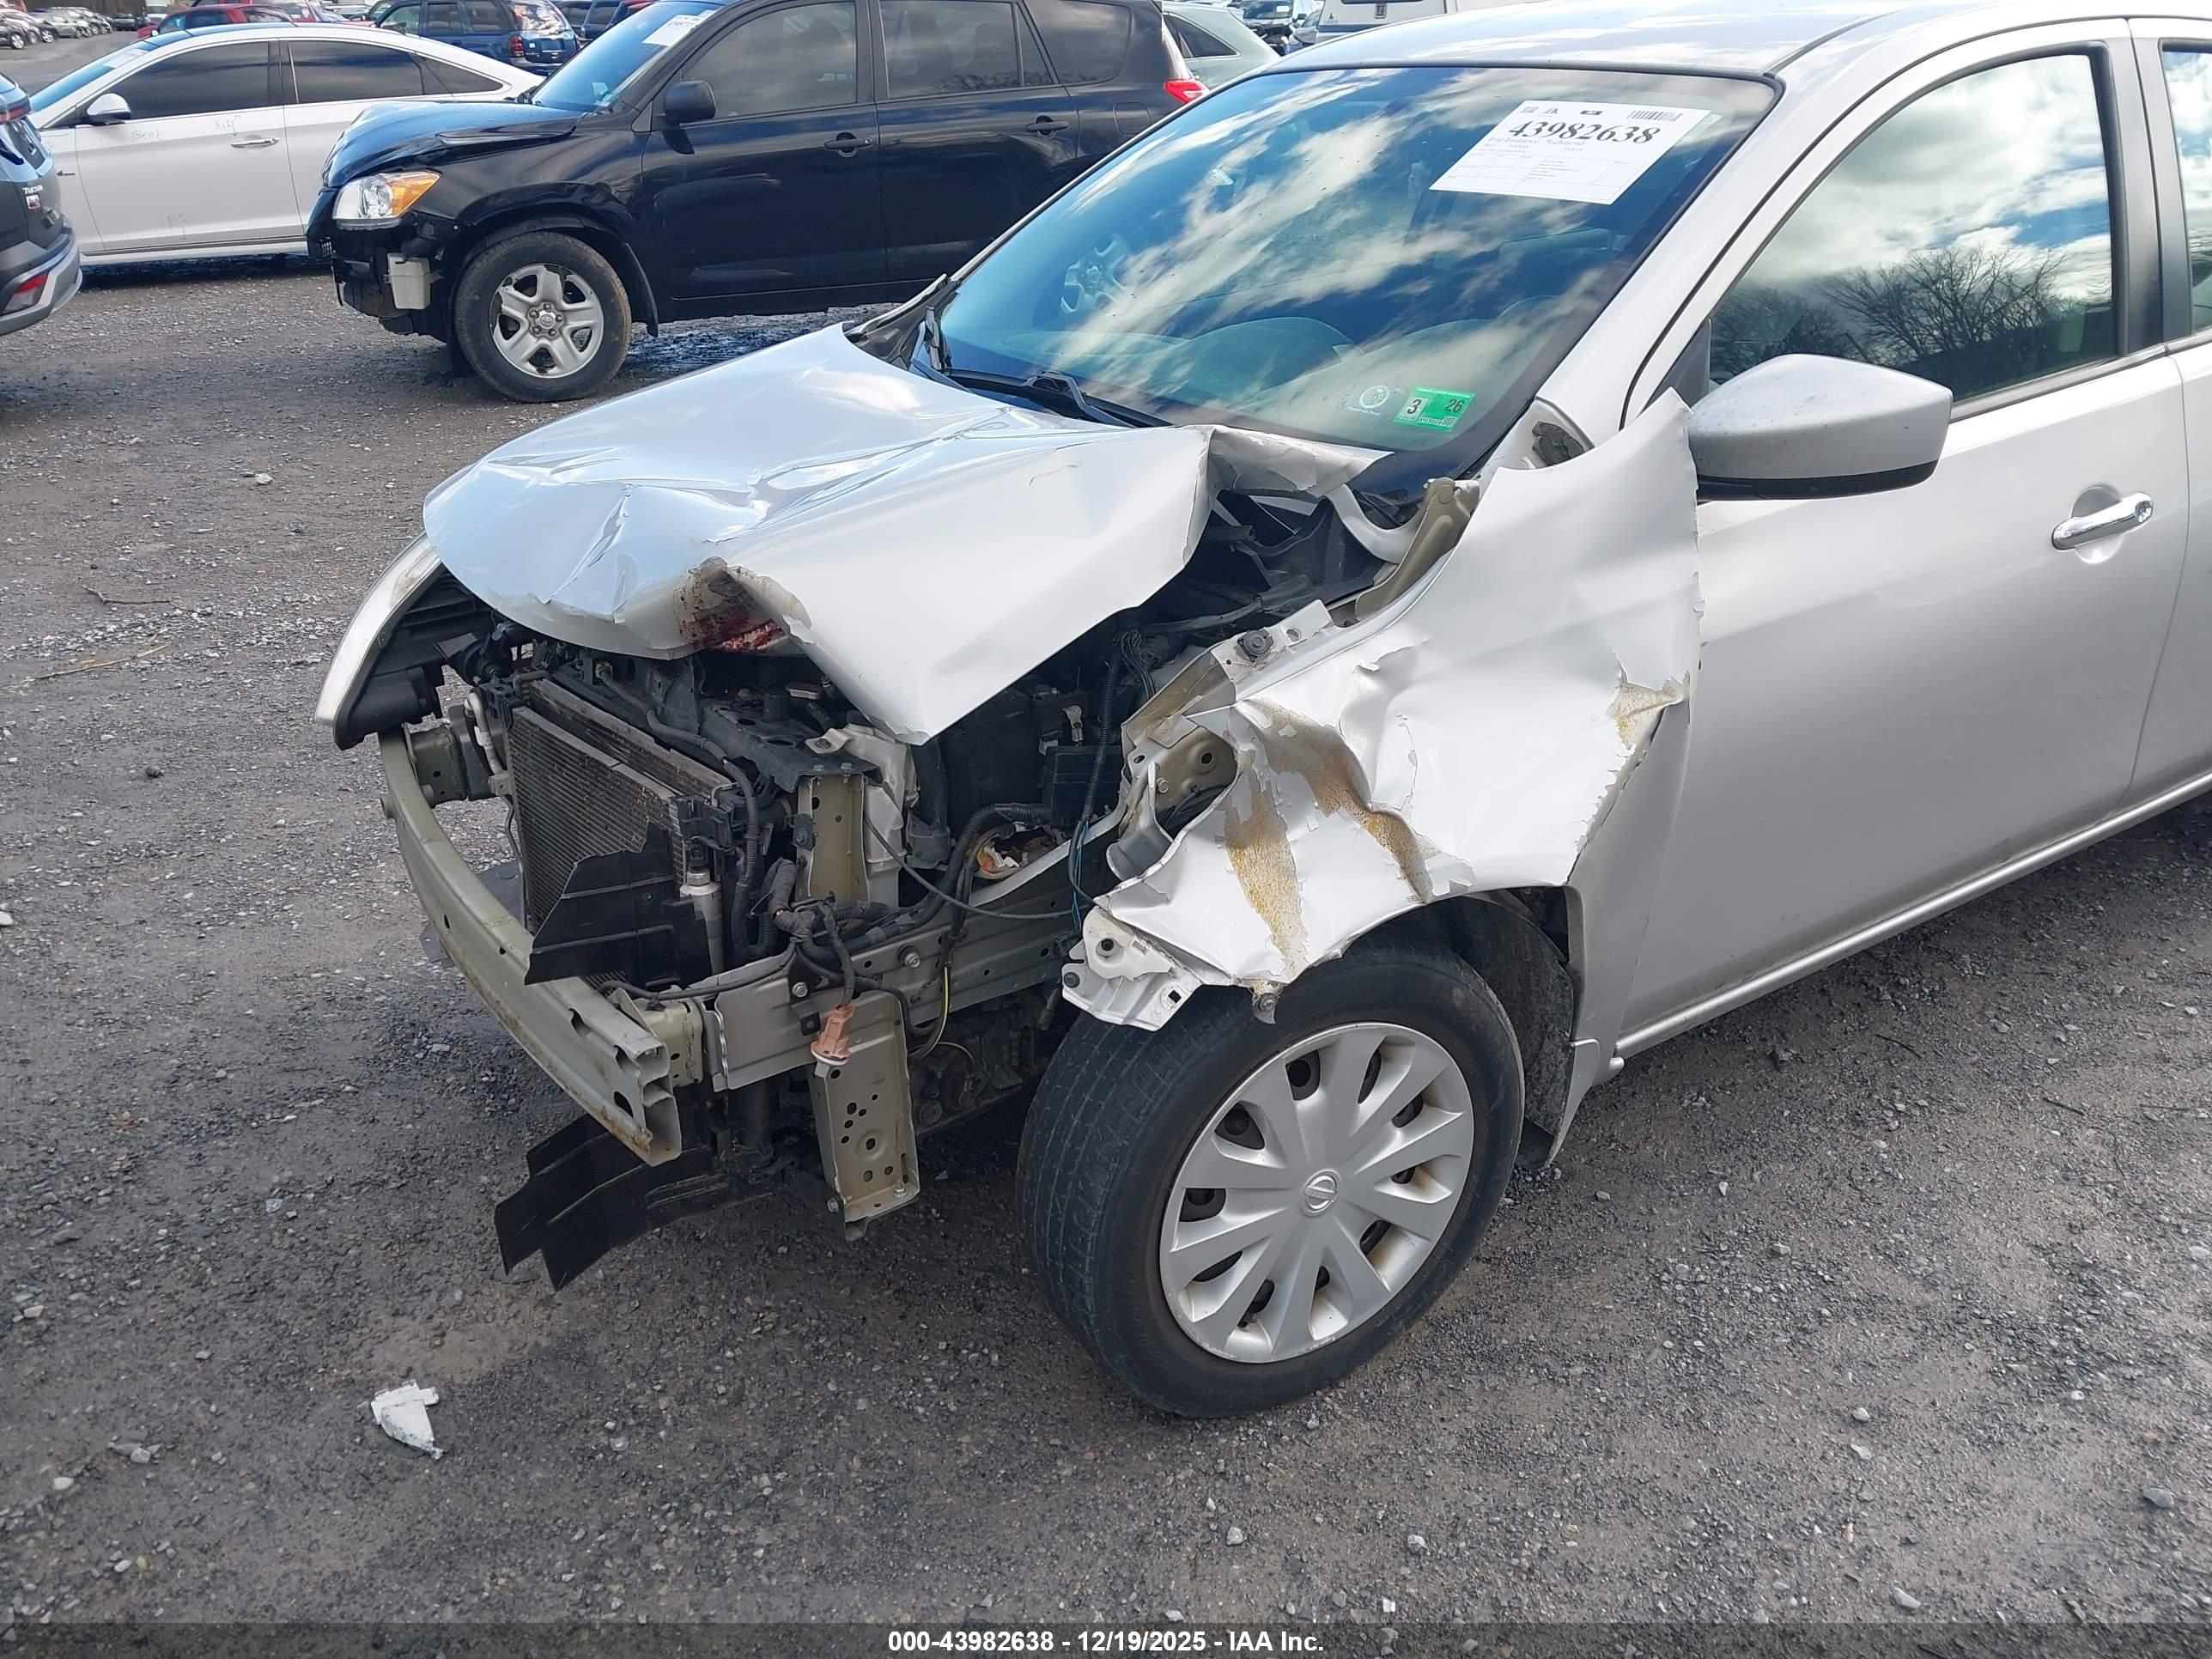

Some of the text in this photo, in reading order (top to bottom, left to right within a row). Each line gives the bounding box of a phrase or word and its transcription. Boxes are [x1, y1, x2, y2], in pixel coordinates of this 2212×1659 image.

[1508, 120, 1661, 143] 43982638
[1407, 398, 1422, 415] 3
[1443, 398, 1465, 413] 26
